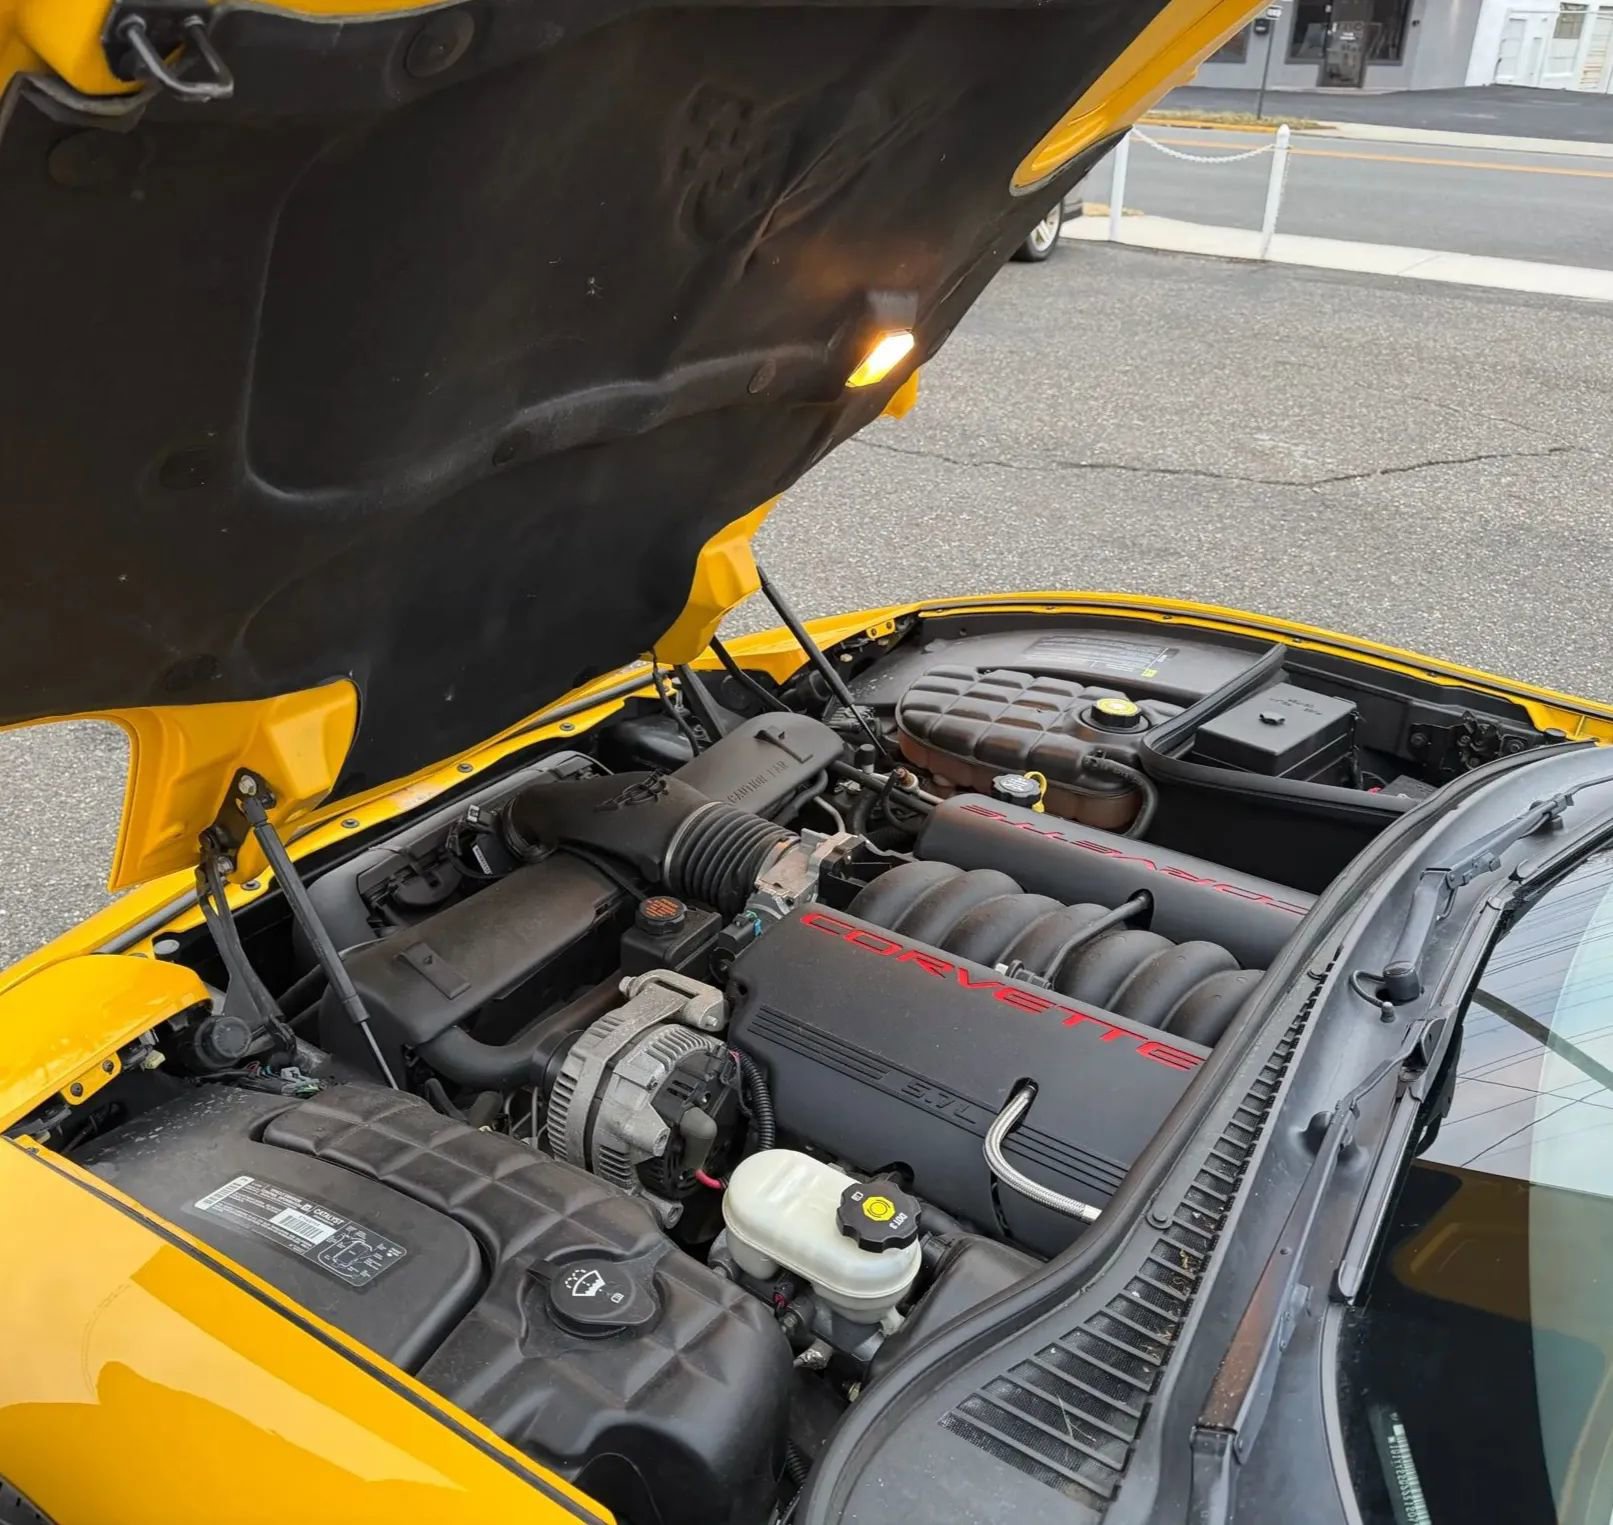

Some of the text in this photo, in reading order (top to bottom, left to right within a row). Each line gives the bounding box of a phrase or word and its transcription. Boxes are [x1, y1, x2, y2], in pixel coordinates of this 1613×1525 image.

[800, 912, 1213, 1071] CORVETTE
[900, 1080, 978, 1124] 5.7L
[313, 1208, 345, 1225] CATALYST
